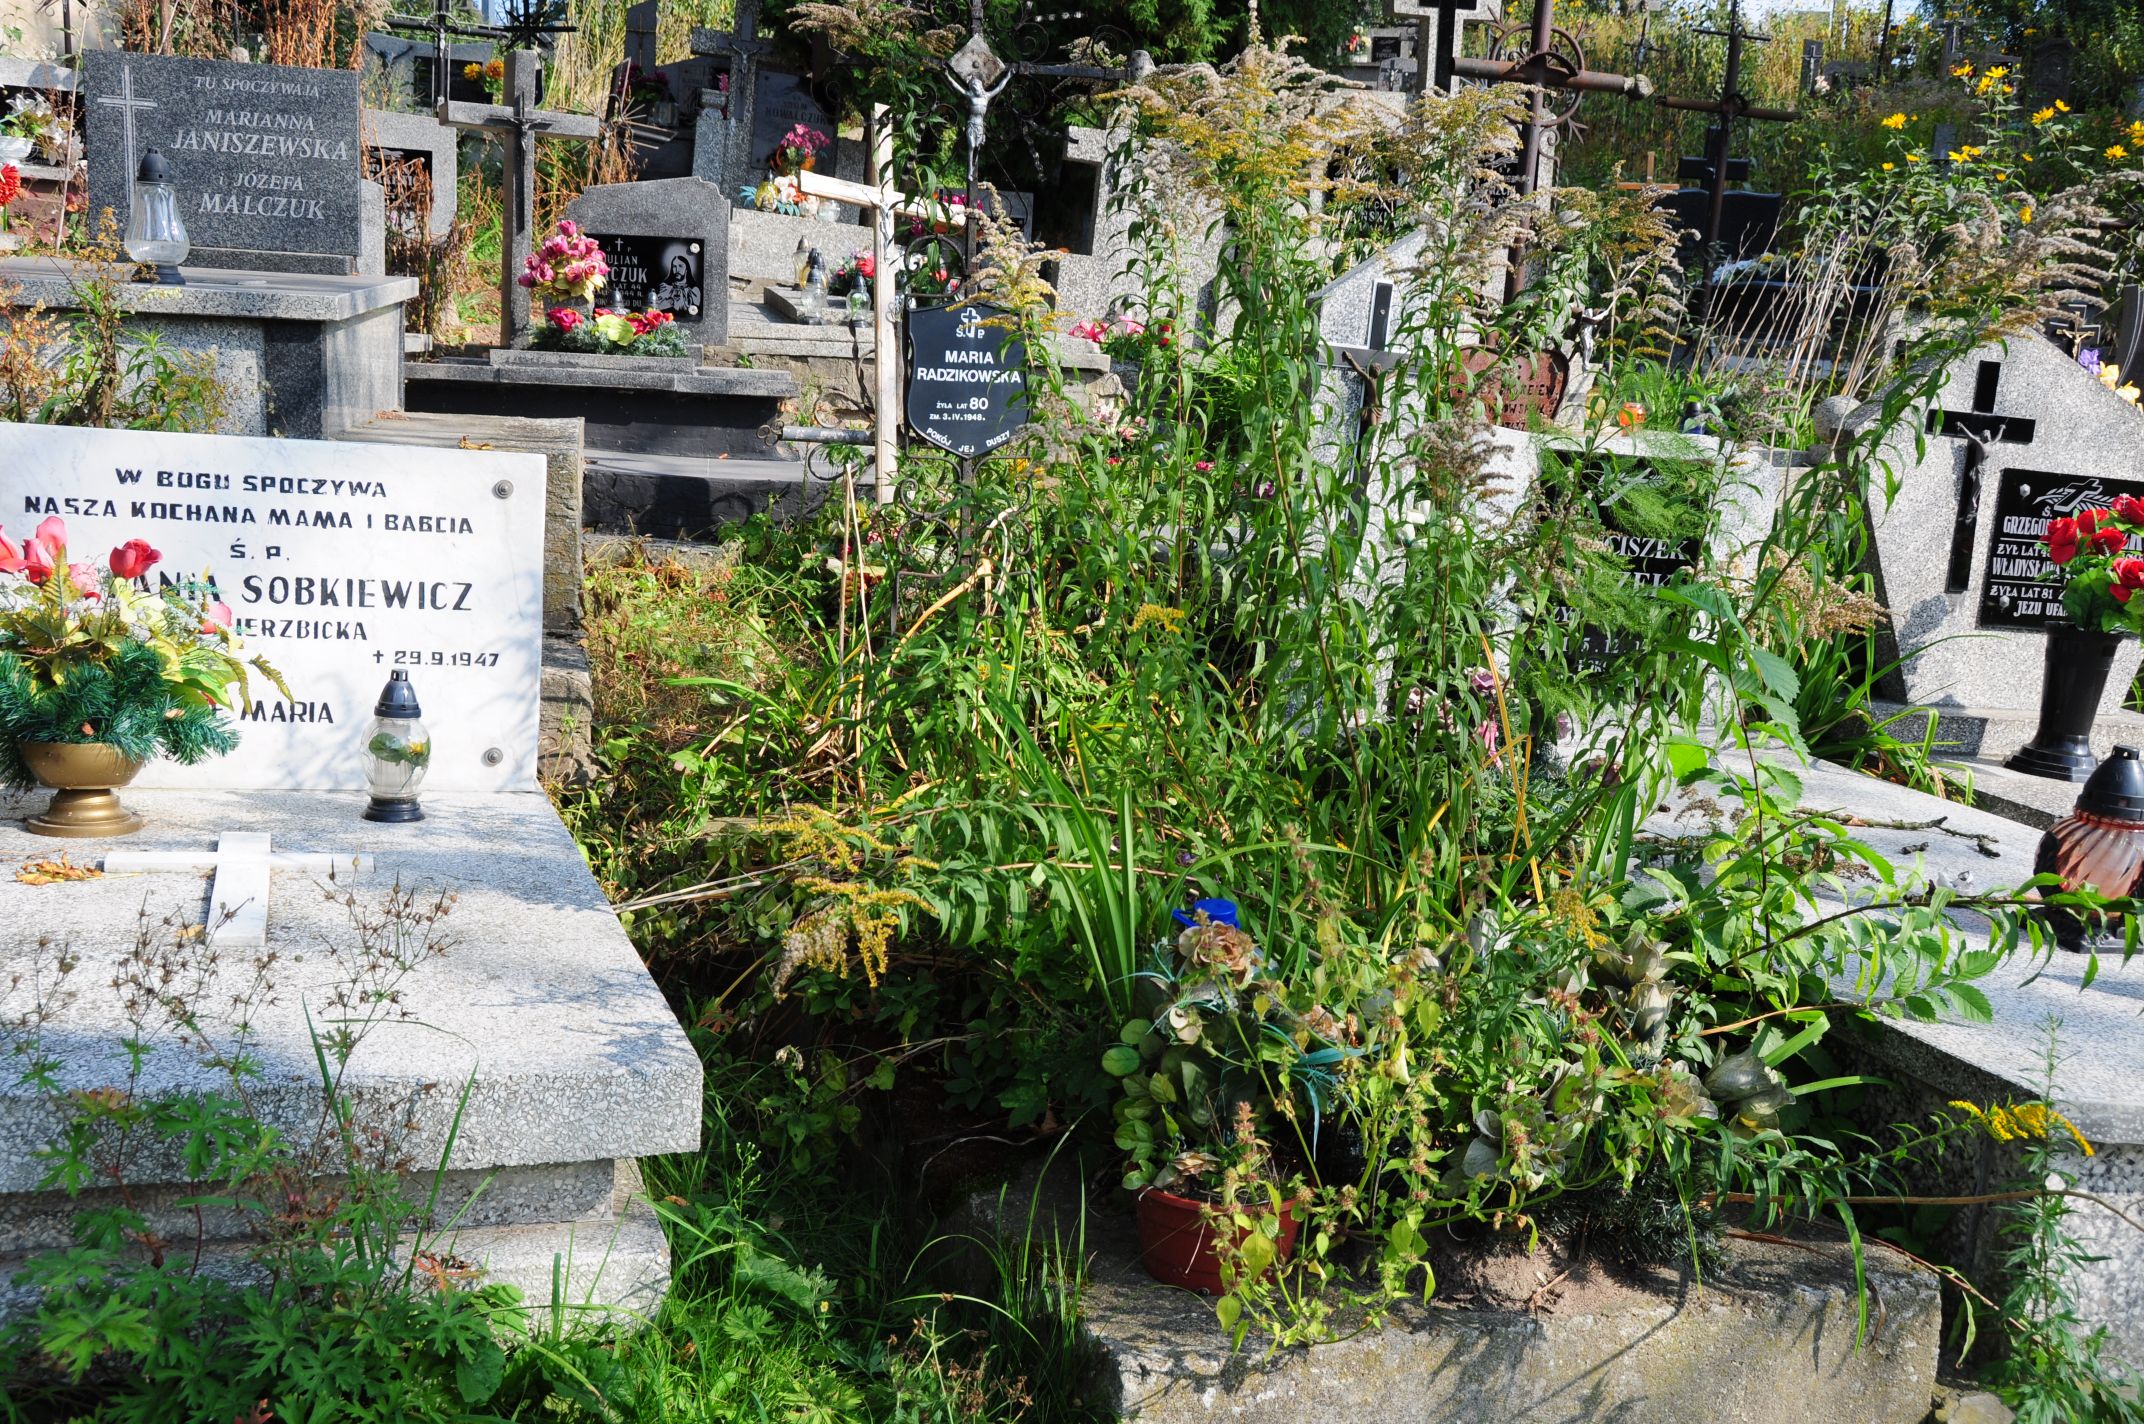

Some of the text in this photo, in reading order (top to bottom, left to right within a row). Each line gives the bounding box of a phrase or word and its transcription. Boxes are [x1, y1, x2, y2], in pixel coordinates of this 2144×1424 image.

[195, 76, 319, 99] TU SPOCZYWAJĄ
[205, 109, 315, 131] MARIANNA
[171, 129, 348, 160] JANISZEWSKA
[233, 170, 304, 191] JÓZEFA
[200, 192, 325, 220] MALCZUK
[607, 254, 638, 266] ULIAN
[945, 350, 994, 364] MARIA
[917, 367, 1021, 383] RADZIKOWSKA
[969, 397, 989, 410] 80
[926, 427, 1010, 453] POKÓJ JEJ DUSZY
[115, 468, 387, 497] W BOGU SPOCZYWA
[24, 495, 474, 534] NASZA KOCHANA MAMA I BABCIA
[1605, 535, 1689, 560] CISZEK
[241, 575, 473, 611] SOBKIEWICZ
[1990, 585, 2017, 597] ŻYŁA
[2021, 587, 2040, 598] LAT
[2041, 588, 2053, 598] 81
[2014, 601, 2067, 617] JEZU UFA
[236, 617, 368, 641] IERZBICKA
[394, 650, 499, 667] 29.9.1947
[240, 700, 334, 724] MARIA
